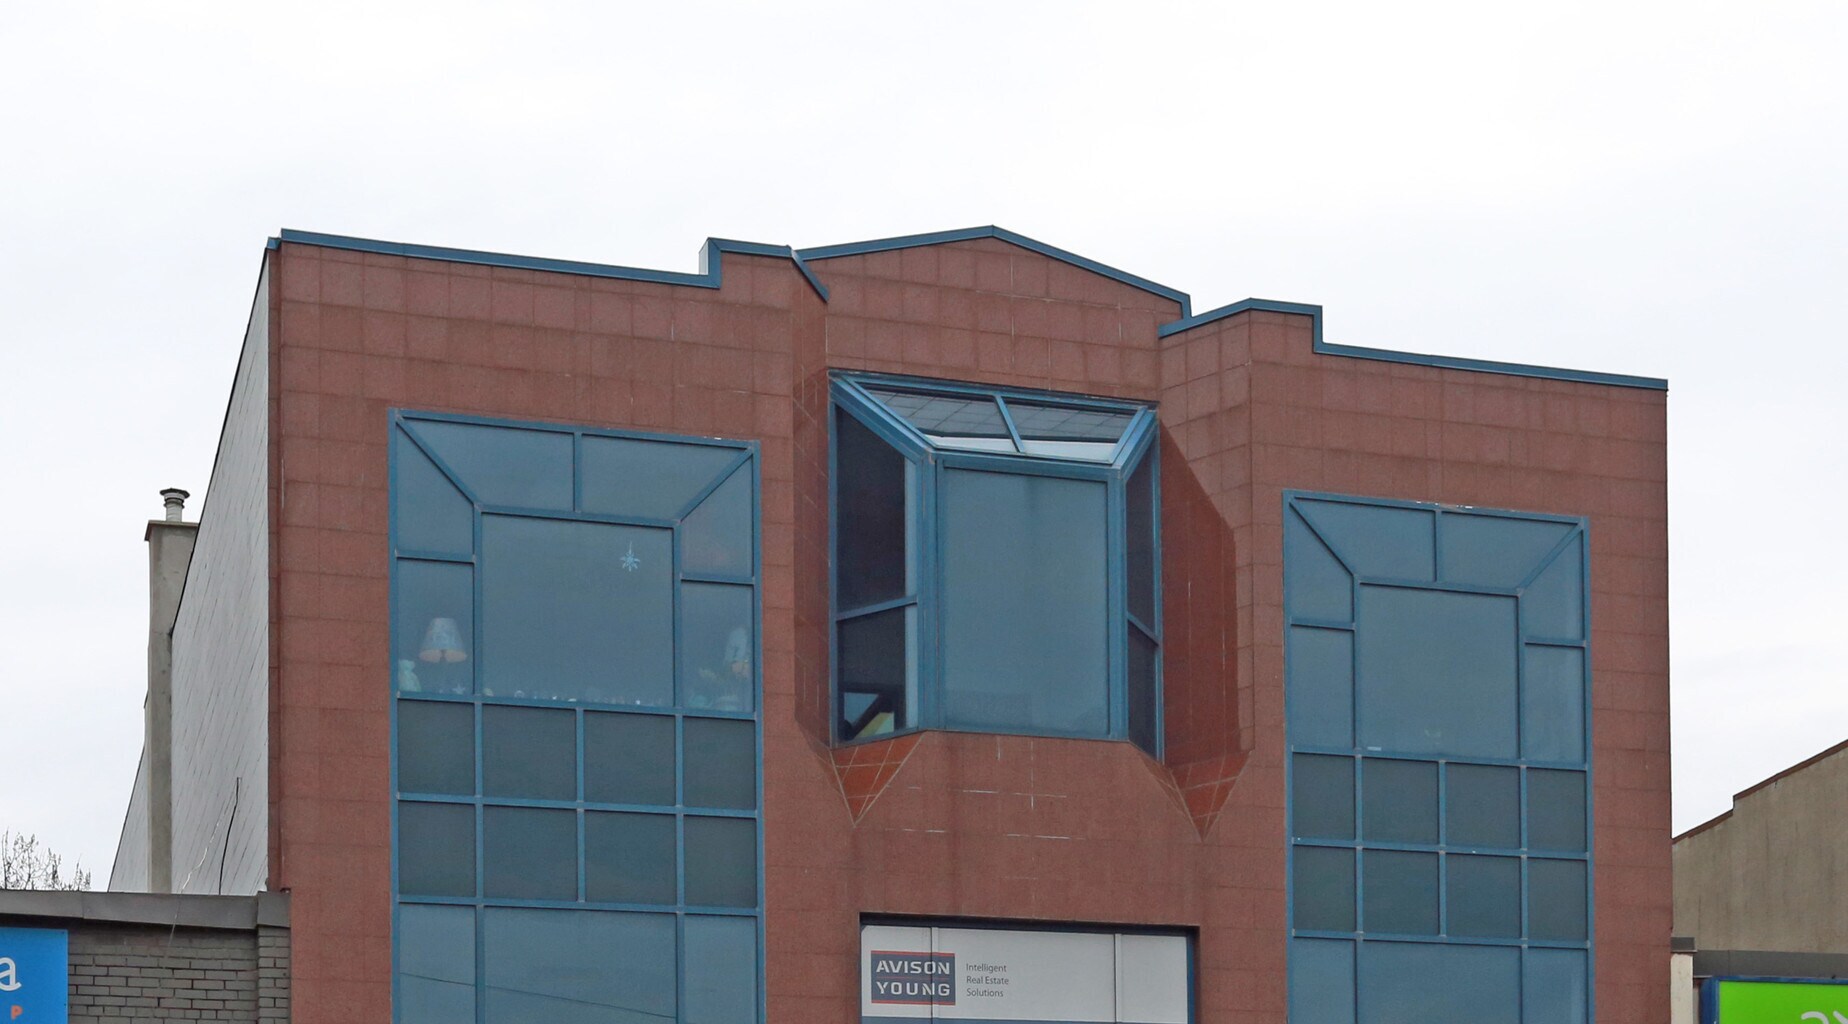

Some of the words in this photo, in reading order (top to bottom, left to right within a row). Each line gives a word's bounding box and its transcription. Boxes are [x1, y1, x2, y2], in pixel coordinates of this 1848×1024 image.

[876, 959, 951, 975] AVISON
[966, 963, 1007, 974] Intelligent
[966, 975, 984, 985] Real
[985, 976, 1009, 986] Estate
[876, 980, 951, 997] YOUNG
[966, 987, 1004, 998] Solutions
